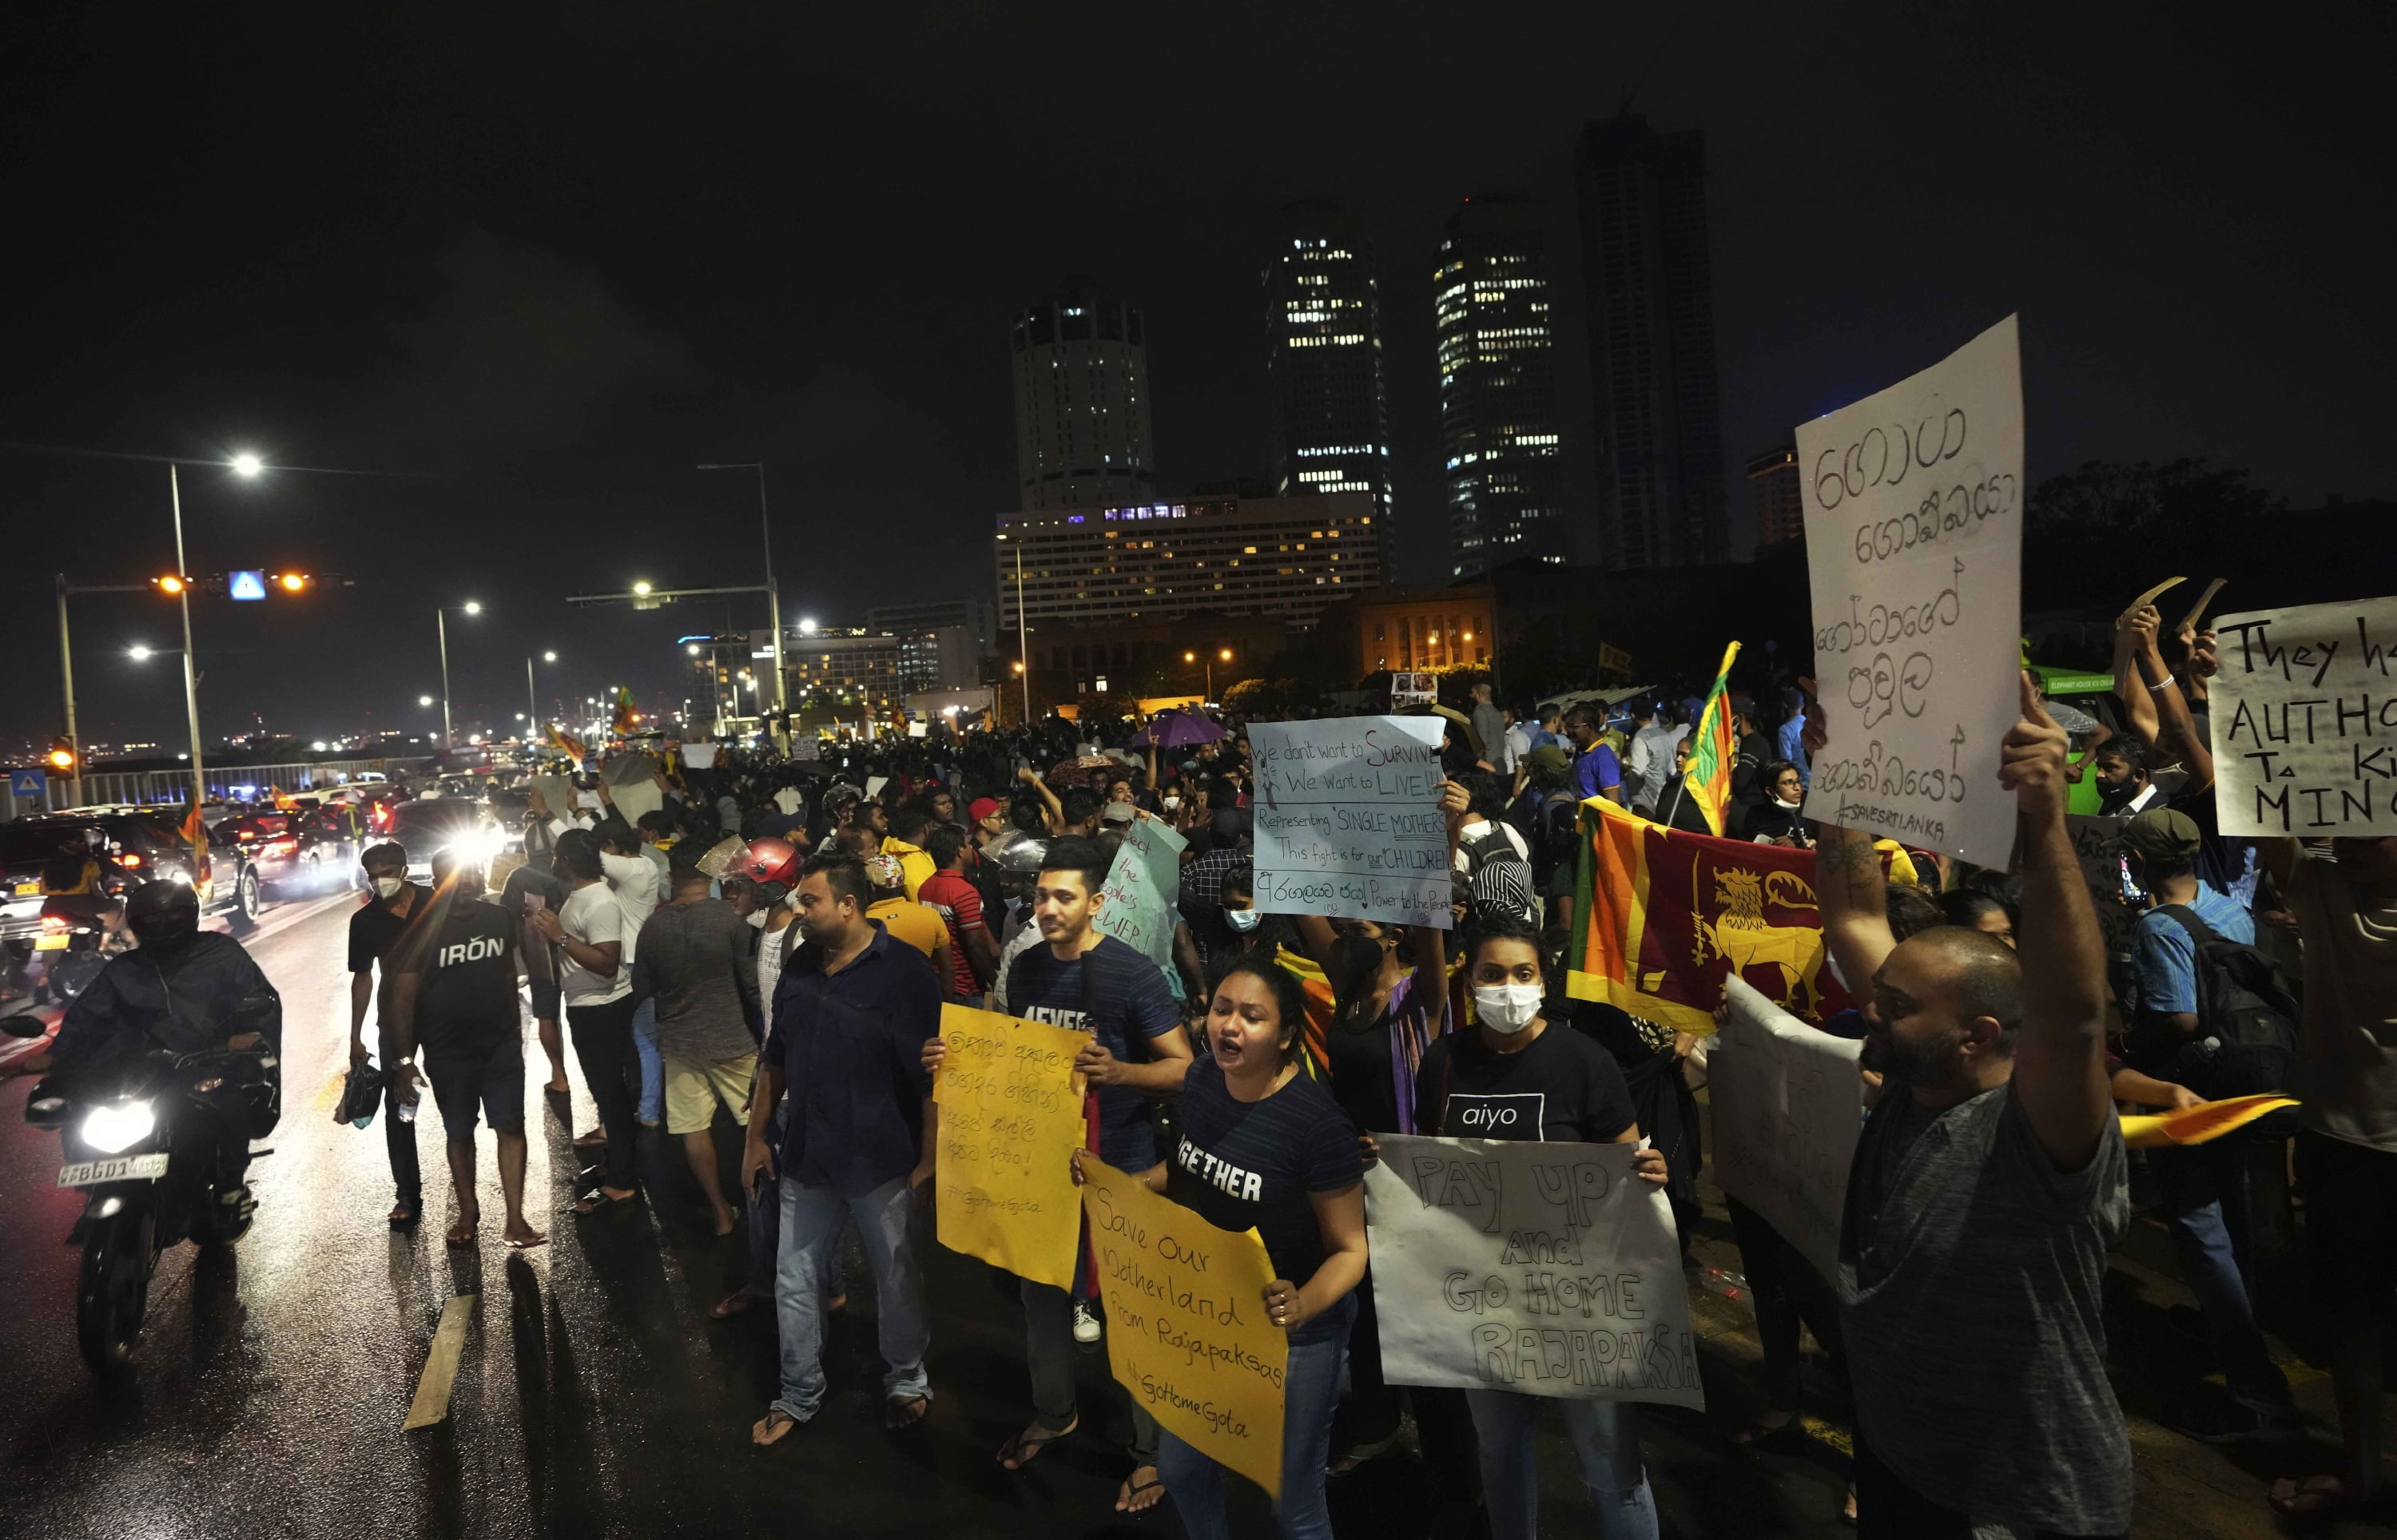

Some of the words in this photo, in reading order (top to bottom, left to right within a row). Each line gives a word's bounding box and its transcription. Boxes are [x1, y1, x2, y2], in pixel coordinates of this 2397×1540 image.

[2217, 619, 2339, 688] They
[1250, 737, 1278, 760] We
[1284, 734, 1316, 760] don't
[1352, 742, 1364, 758] to
[1286, 768, 1318, 792] We
[1360, 776, 1373, 789] to
[2255, 779, 2397, 832] MIN
[1274, 836, 1307, 859] This
[1312, 843, 1337, 866] fight
[1340, 849, 1348, 860] is
[1352, 847, 1365, 861] for
[1368, 854, 1382, 864] our
[1119, 857, 1139, 883] the
[1369, 879, 1398, 907] Power
[1401, 890, 1411, 909] to
[1413, 892, 1429, 910] the
[439, 936, 504, 968] IRON
[1462, 1104, 1517, 1130] aiyo
[1413, 1157, 1502, 1233] PAY
[1097, 1187, 1147, 1248] Save
[1158, 1235, 1211, 1272] Our
[1444, 1272, 1509, 1315] GO
[1525, 1272, 1644, 1320] HOME
